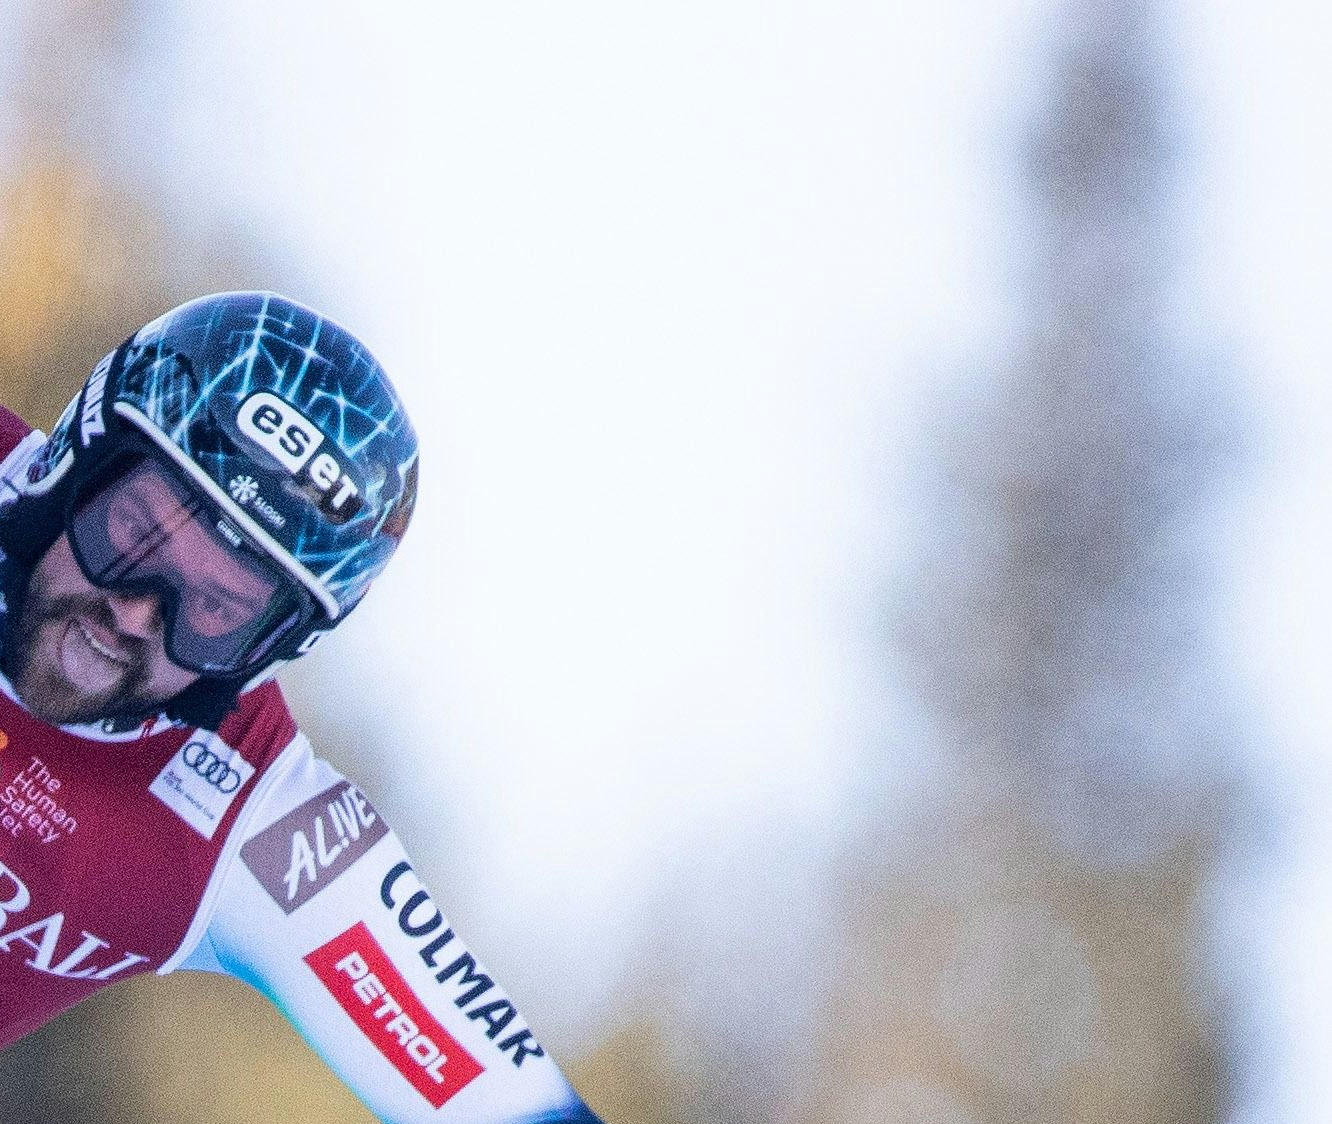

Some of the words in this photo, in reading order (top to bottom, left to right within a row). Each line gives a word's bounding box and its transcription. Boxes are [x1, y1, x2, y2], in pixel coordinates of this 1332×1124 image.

[12, 771, 78, 833] Human
[27, 756, 62, 792] The
[0, 785, 61, 844] Safety
[379, 861, 546, 1070] COLMAR
[335, 951, 451, 1084] PETROL
